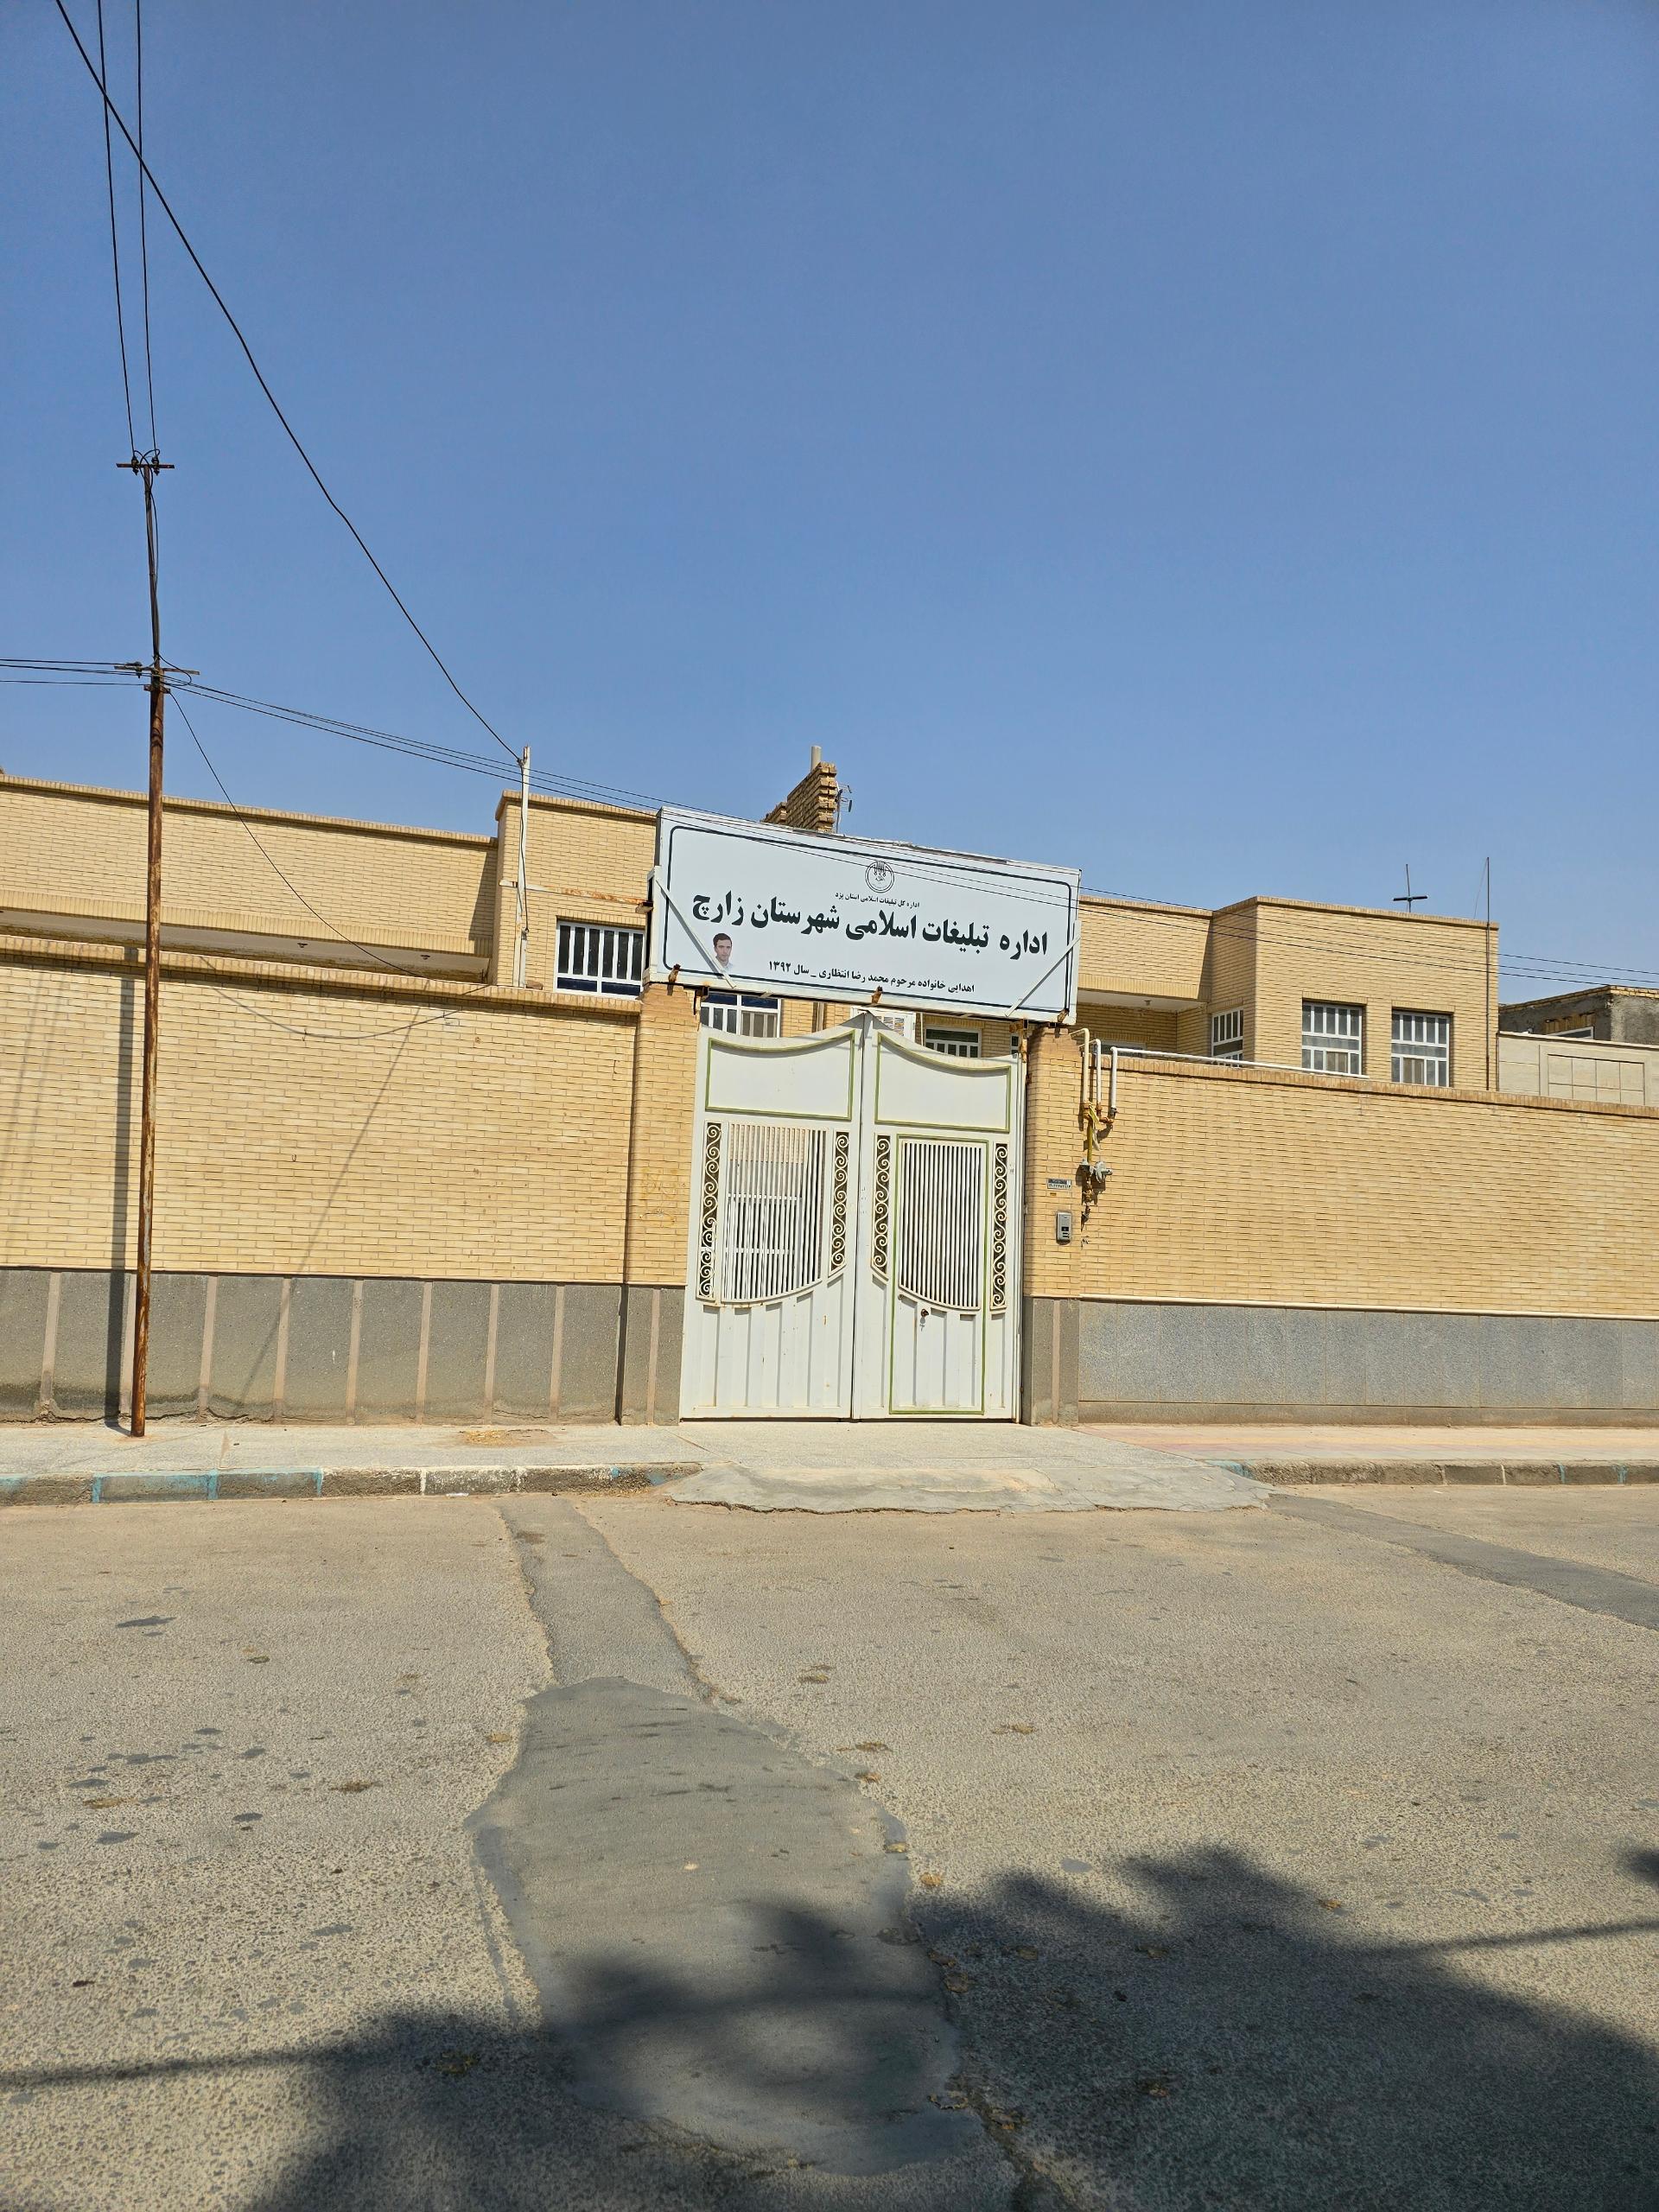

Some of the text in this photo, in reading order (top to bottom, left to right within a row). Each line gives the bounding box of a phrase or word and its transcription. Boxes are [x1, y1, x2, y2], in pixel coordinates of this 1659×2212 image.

[880, 898, 897, 906] تبلیغات
[906, 901, 920, 910] اداره
[692, 890, 1048, 961] اداره تبلیغات اسلامی شهرستان زارچ
[769, 960, 791, 972] ۱۳۹۲
[793, 963, 810, 976] سال
[818, 968, 850, 979] انتظاری
[851, 970, 866, 983] رضا
[868, 974, 889, 983] محمد
[891, 977, 916, 988] مرحوم
[918, 979, 946, 991] خانواده
[947, 983, 975, 994] اهدایی
